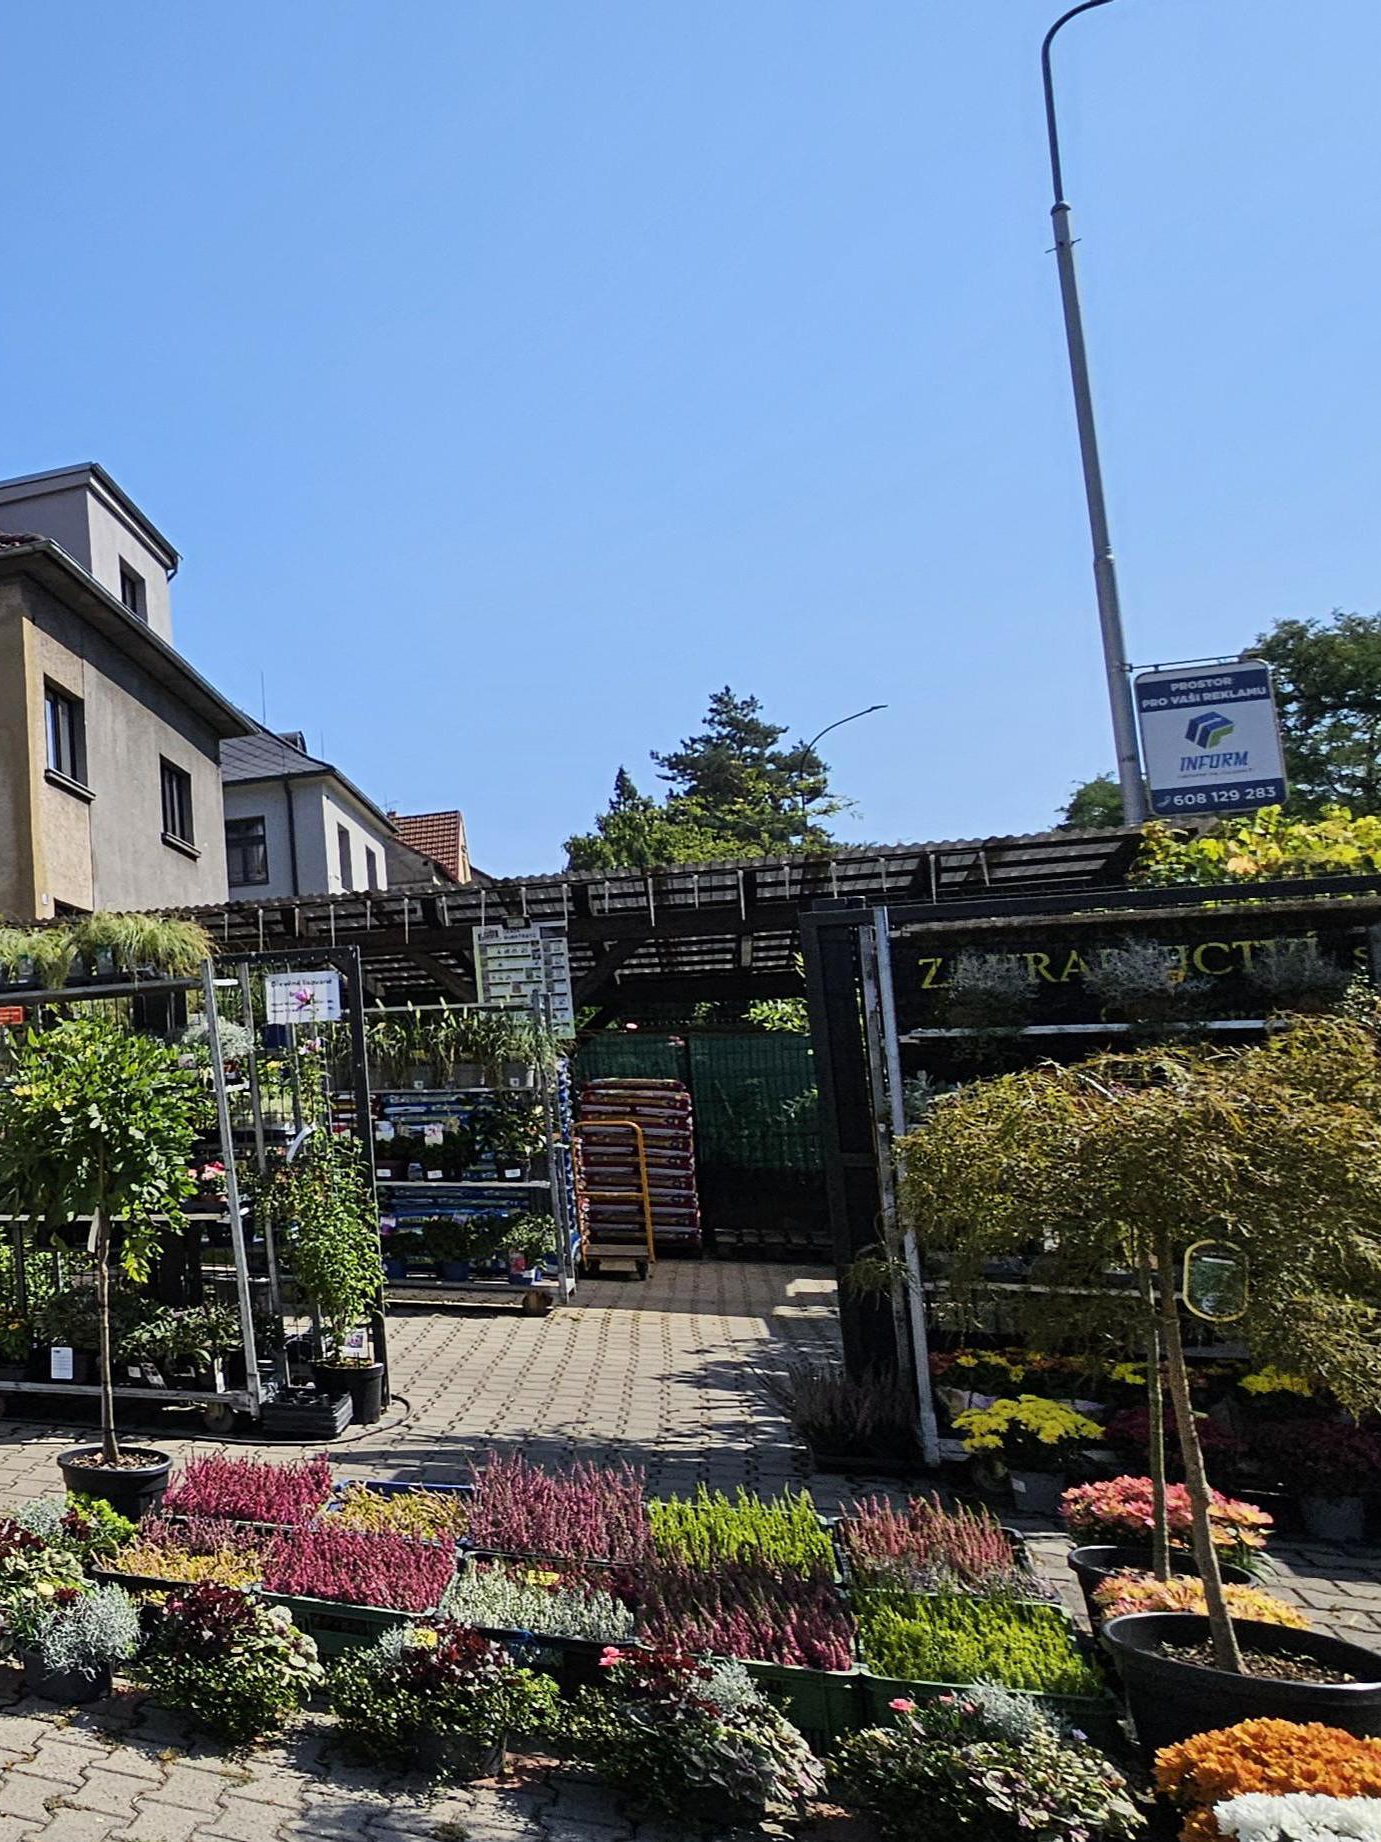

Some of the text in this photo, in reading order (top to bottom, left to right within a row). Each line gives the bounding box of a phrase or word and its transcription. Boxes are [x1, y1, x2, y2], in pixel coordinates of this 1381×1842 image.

[1170, 677, 1233, 692] PROSTOR
[1142, 687, 1267, 708] PRO VAŠI REKLAMU
[1180, 751, 1248, 772] INFORM
[1173, 786, 1276, 806] 608 129 283
